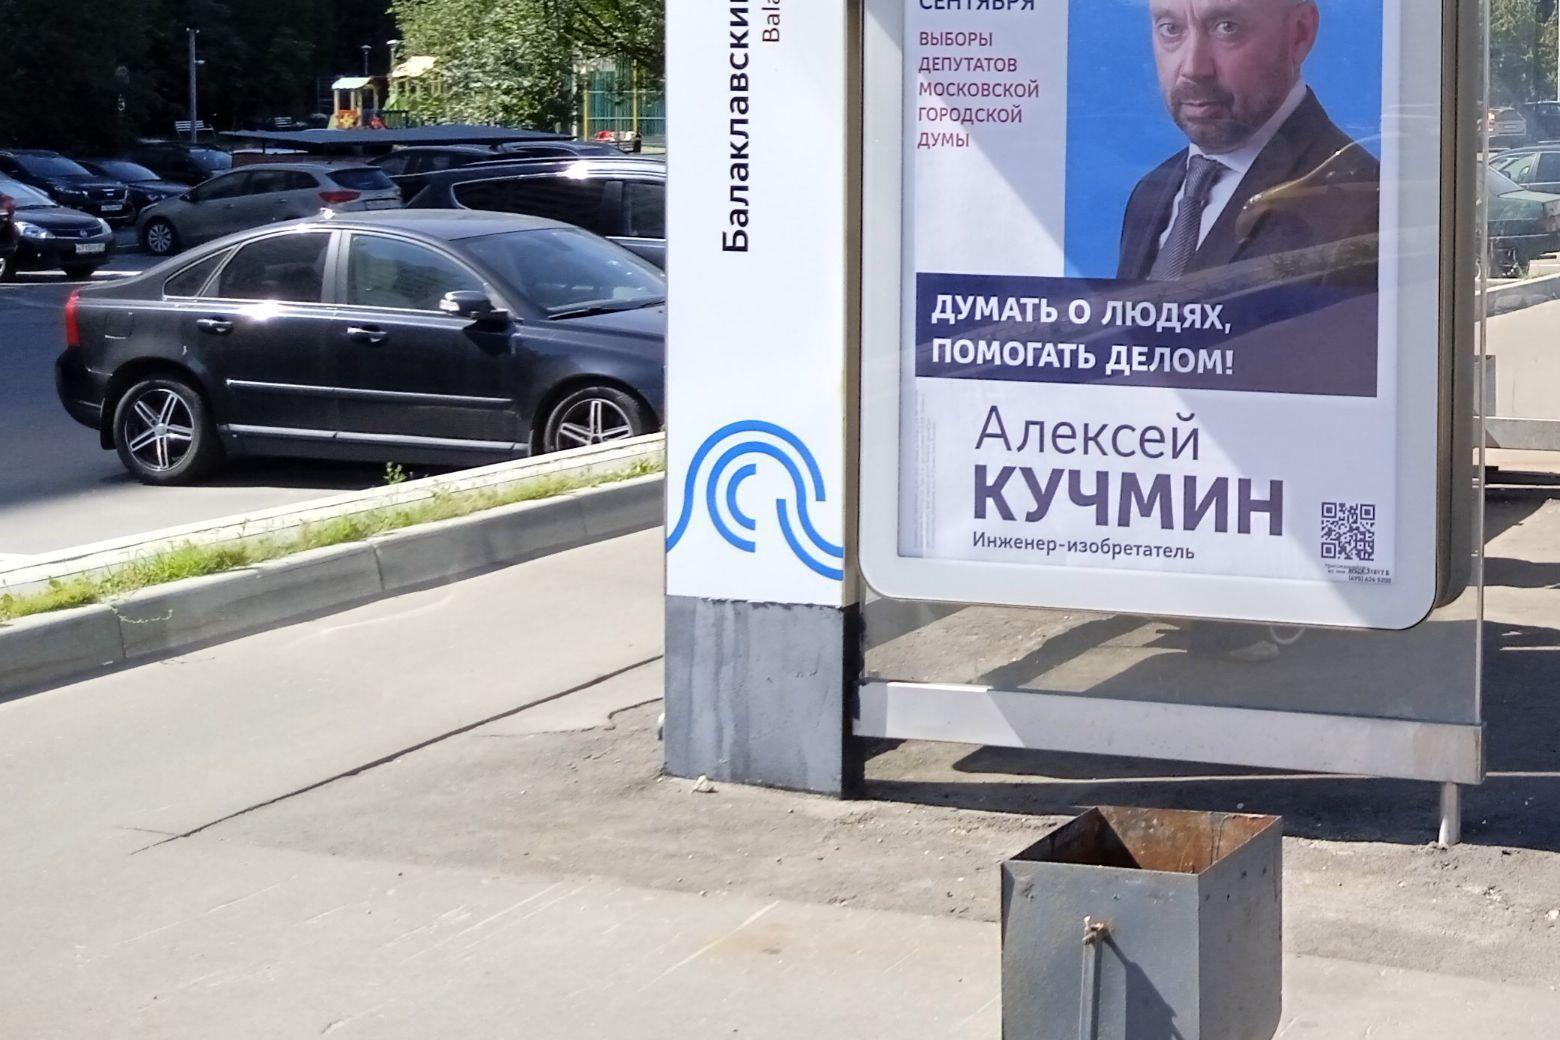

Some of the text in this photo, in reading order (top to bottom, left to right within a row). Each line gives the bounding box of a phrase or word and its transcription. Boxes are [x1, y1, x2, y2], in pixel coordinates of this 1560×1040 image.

[919, 31, 993, 47] ВЫБОРЫ
[918, 56, 1018, 74] ДЕПУТАТОВ
[918, 79, 1040, 98] МОСКОВСКОЙ
[918, 104, 1023, 125] ГОРОДСКОЙ
[917, 132, 970, 150] ДУМЫ
[931, 295, 1232, 334] ДУМАТЬ О ЛЮДЯХ,
[931, 338, 1234, 376] ПОМОГАТЬ ДЕЛОМ!
[974, 405, 1200, 461] Алексей
[973, 463, 1284, 537] КУЧМИН
[972, 531, 1196, 560] Инженер-изобретатель
